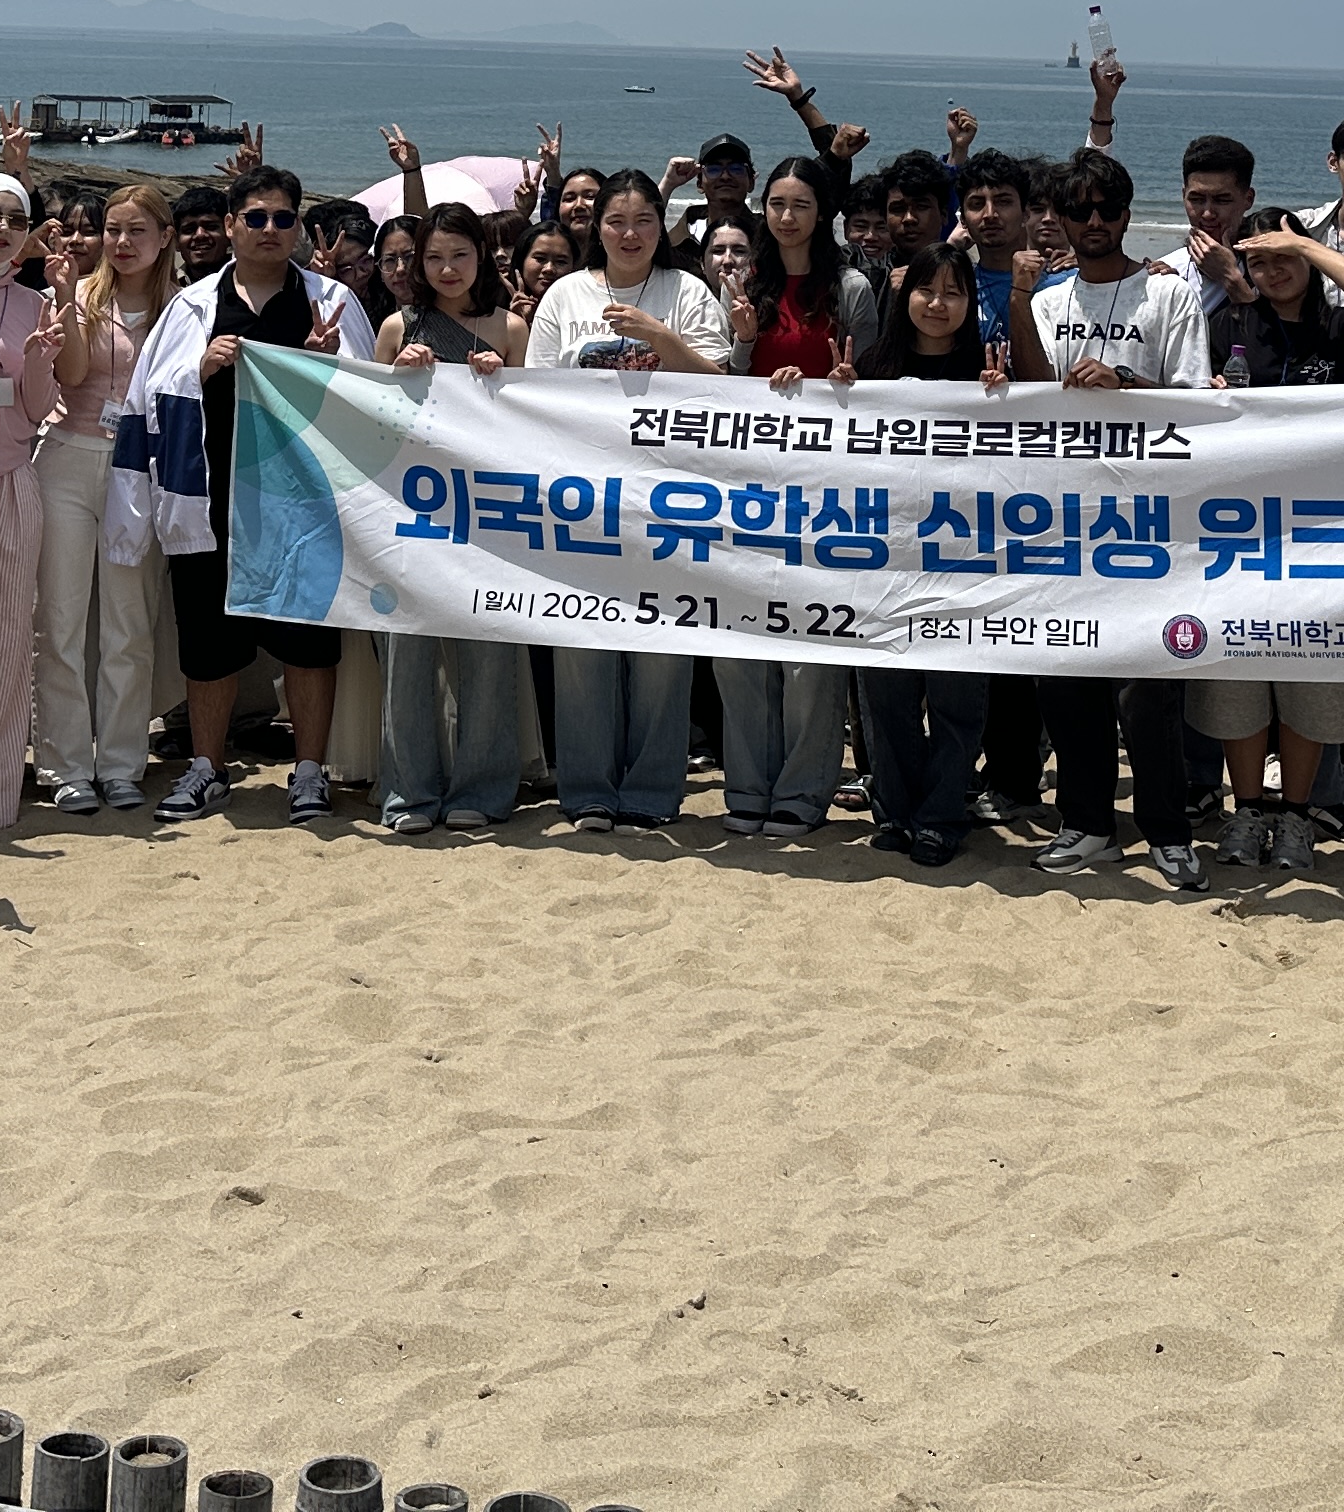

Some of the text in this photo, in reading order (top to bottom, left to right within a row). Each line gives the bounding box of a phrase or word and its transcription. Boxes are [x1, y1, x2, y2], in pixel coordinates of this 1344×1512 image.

[1055, 322, 1145, 344] PRADA
[628, 406, 1192, 462] 전북대학교 남원글로컬캠퍼스
[395, 464, 623, 557] 외국인
[646, 480, 890, 570] 유학생
[917, 490, 1172, 580] 신입생
[542, 592, 627, 624] 2026.
[981, 615, 1038, 646] 부안
[1045, 618, 1099, 648] 일대
[1223, 649, 1263, 658] JEONBUK
[1265, 650, 1307, 659] NATIONAL
